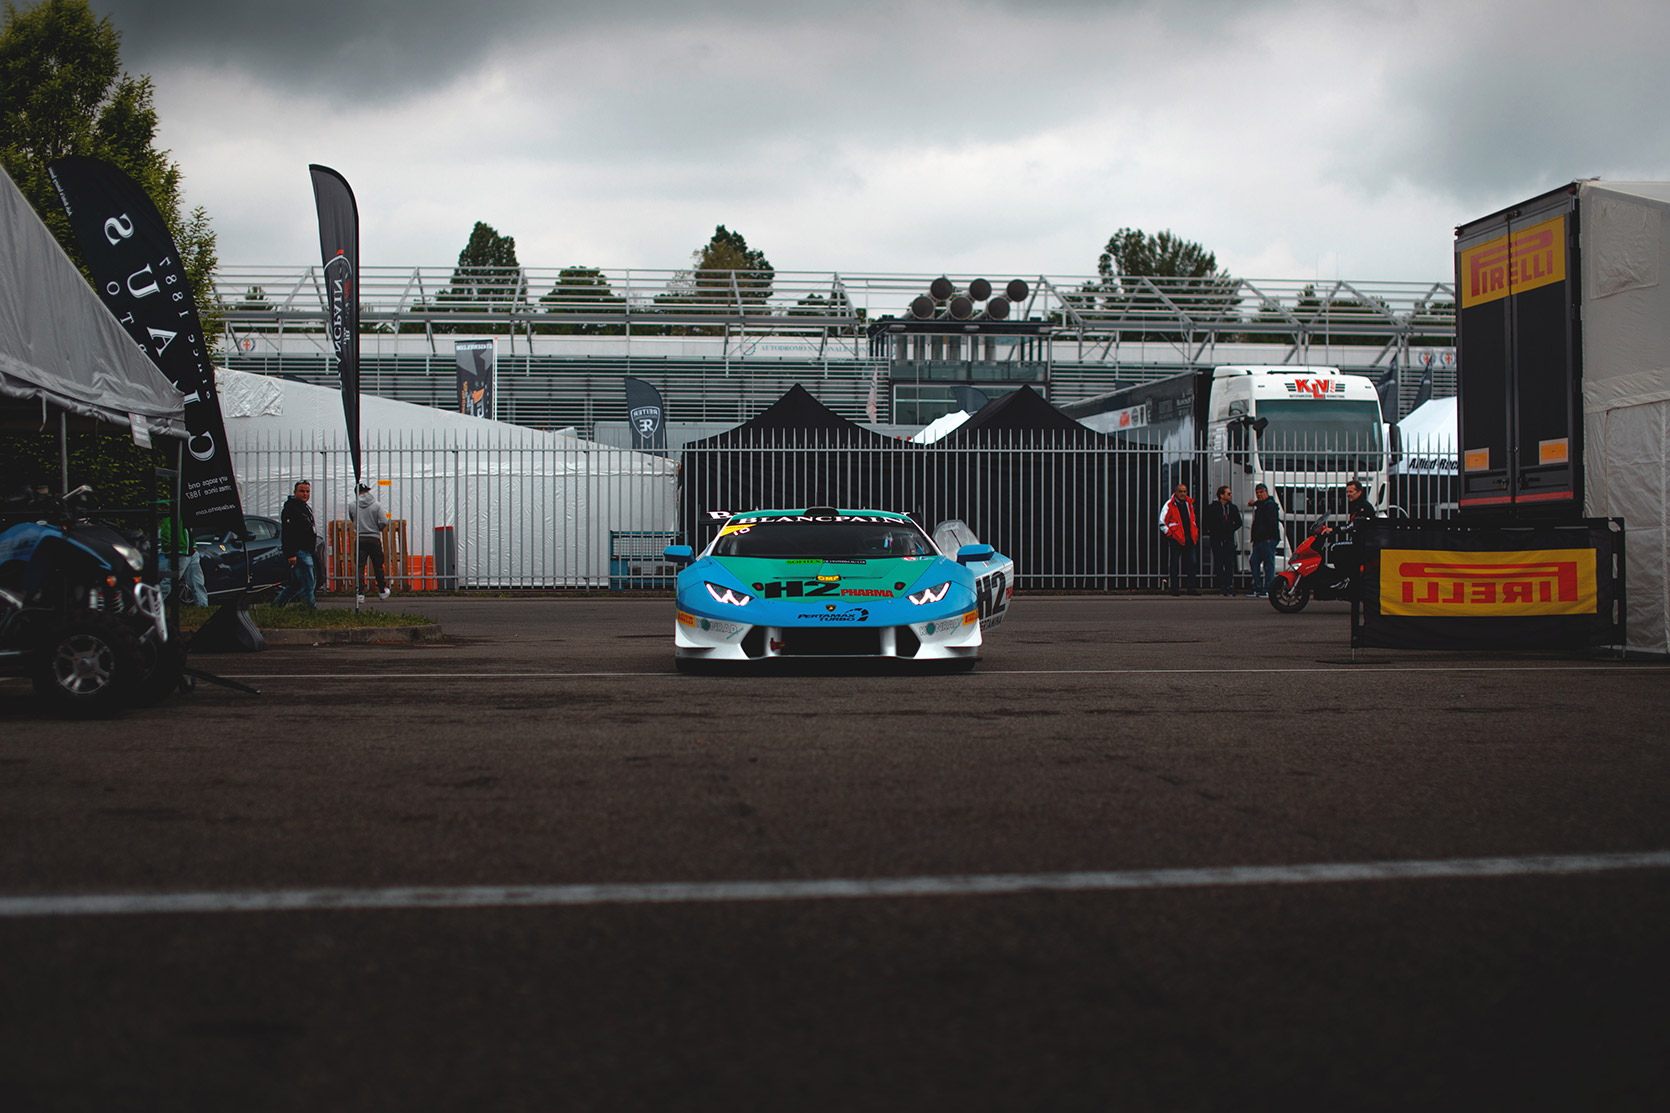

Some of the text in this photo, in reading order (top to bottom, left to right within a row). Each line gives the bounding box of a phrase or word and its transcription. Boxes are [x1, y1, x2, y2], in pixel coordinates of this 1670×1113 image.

[1471, 228, 1554, 297] PIRELLI
[1295, 379, 1330, 399] KLV
[738, 515, 907, 525] BLANCPAIN
[764, 580, 894, 598] H2 PHARMA
[975, 571, 1007, 620] H2
[696, 617, 738, 633] KONRAD
[919, 618, 960, 636] KONRAD
